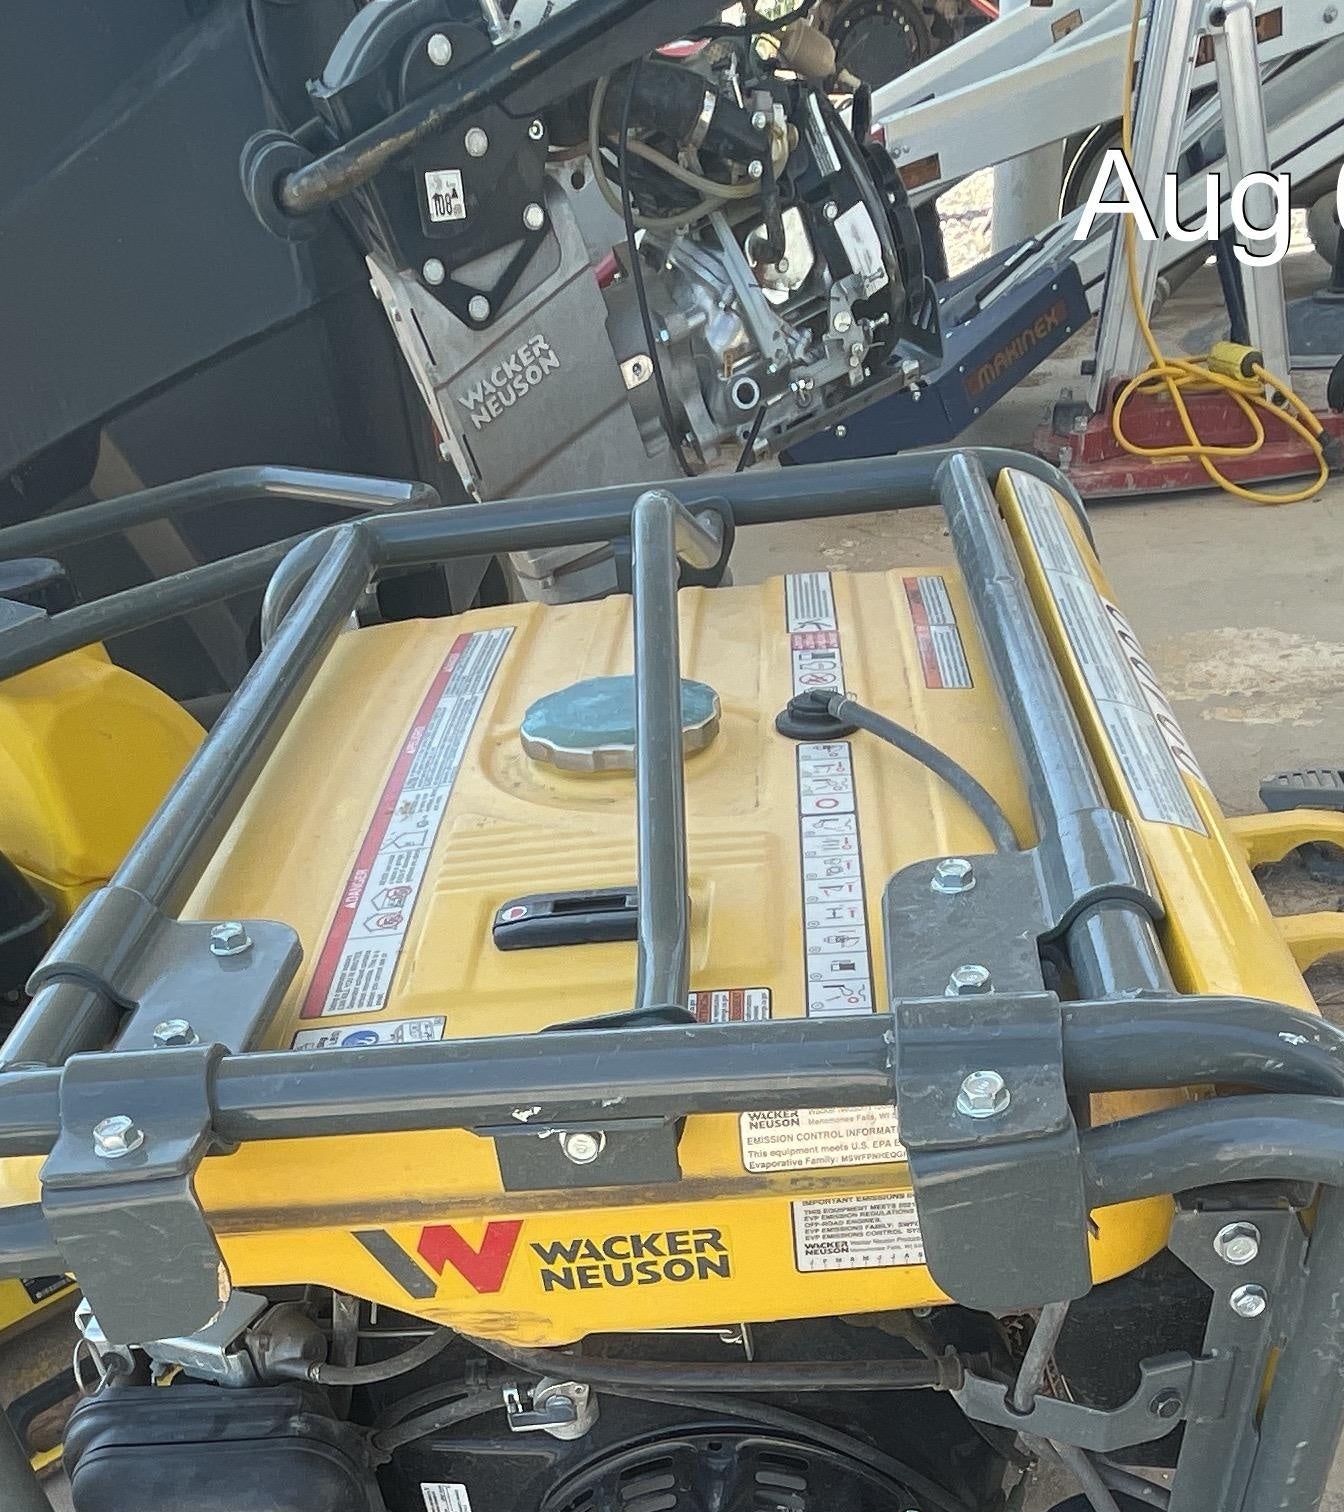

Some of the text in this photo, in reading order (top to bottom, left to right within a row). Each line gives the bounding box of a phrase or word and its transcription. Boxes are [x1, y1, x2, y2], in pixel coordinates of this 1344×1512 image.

[458, 334, 550, 410] WACKER
[471, 349, 560, 430] NEUSON
[749, 1118, 800, 1130] NEUSON
[747, 1125, 897, 1146] EMISSION CONTROL INFORMAT
[748, 1149, 769, 1159] This
[769, 1146, 820, 1159] equipment
[821, 1144, 849, 1153] meets
[851, 1141, 869, 1151] U.S.
[872, 1139, 892, 1149] EPA
[749, 1158, 803, 1171] Evaporative
[805, 1154, 839, 1167] Family:
[859, 1208, 915, 1218] REGULATIONS
[529, 1228, 729, 1266] WACKER
[804, 1240, 849, 1250] WACKER
[805, 1247, 850, 1256] NEUSON
[540, 1254, 731, 1292] NEUSON
